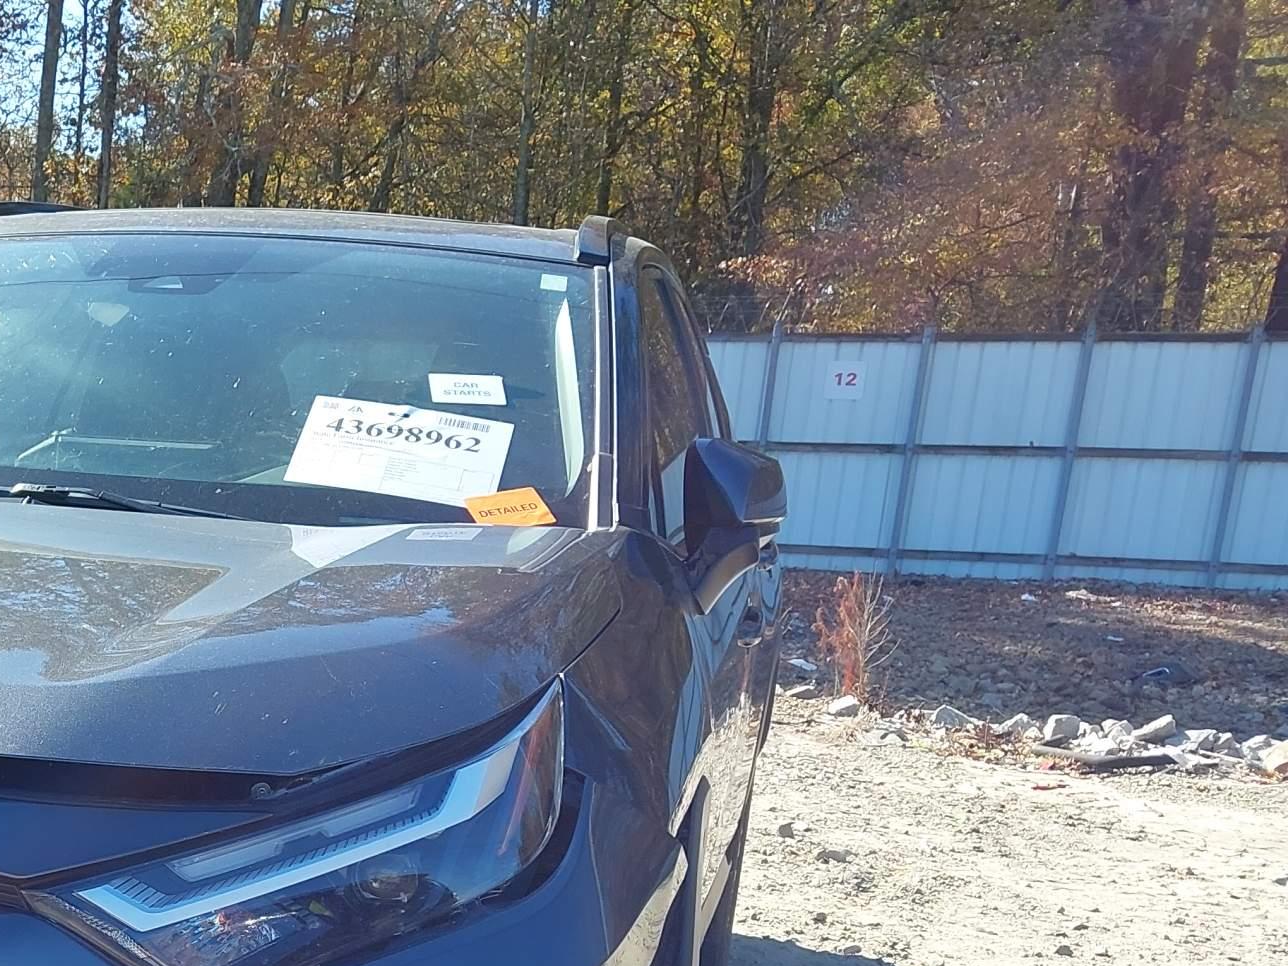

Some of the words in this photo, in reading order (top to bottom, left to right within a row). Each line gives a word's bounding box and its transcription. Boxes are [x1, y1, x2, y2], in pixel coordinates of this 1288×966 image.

[453, 381, 479, 389] CAR
[834, 372, 857, 386] 12
[443, 389, 492, 397] STARTS
[325, 417, 481, 453] 43698962
[478, 502, 538, 518] DETAILED
